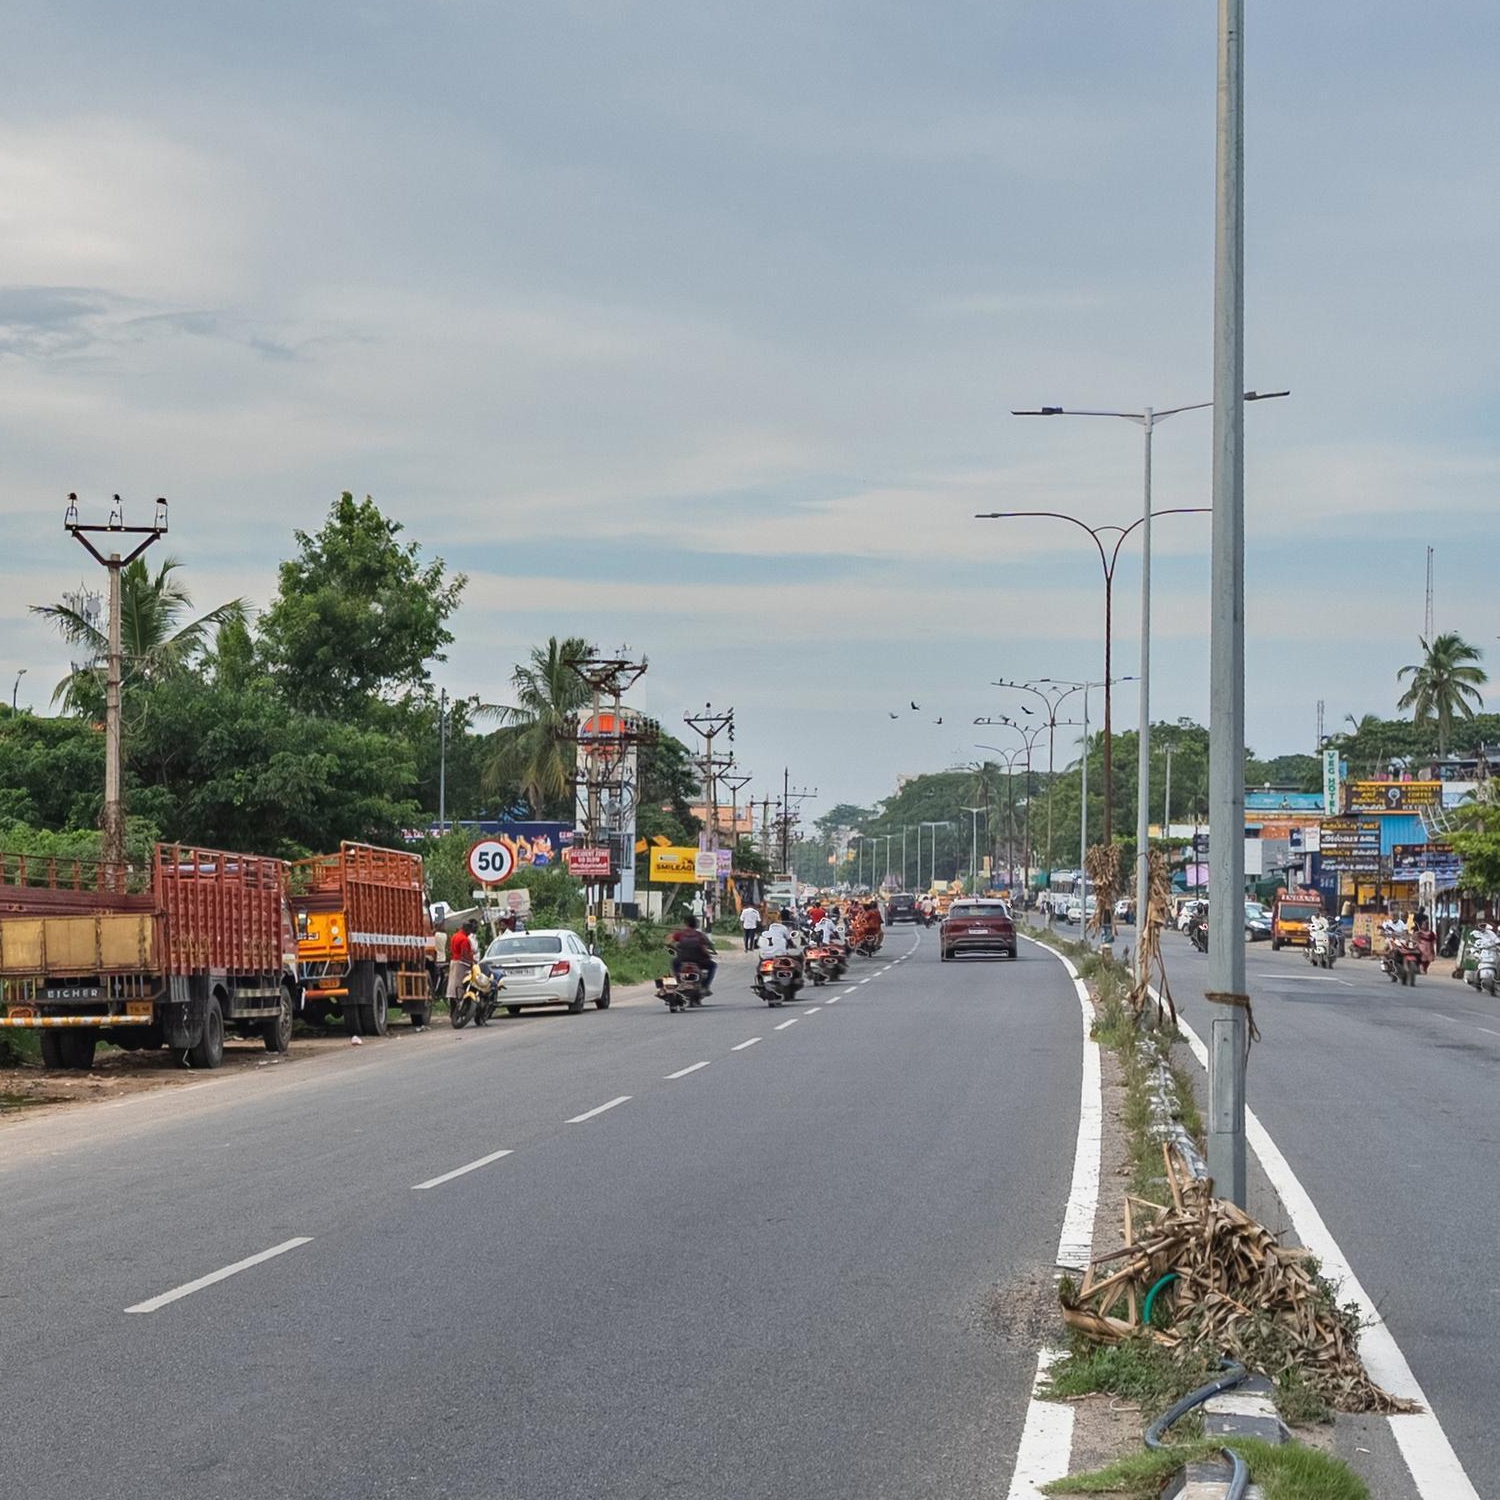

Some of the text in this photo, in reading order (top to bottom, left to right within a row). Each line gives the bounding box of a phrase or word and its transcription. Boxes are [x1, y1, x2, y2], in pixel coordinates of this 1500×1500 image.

[1327, 752, 1336, 815] VEG HOTEL
[478, 852, 504, 872] 50
[656, 863, 696, 872] SMILEAG
[47, 989, 98, 998] EICHER
